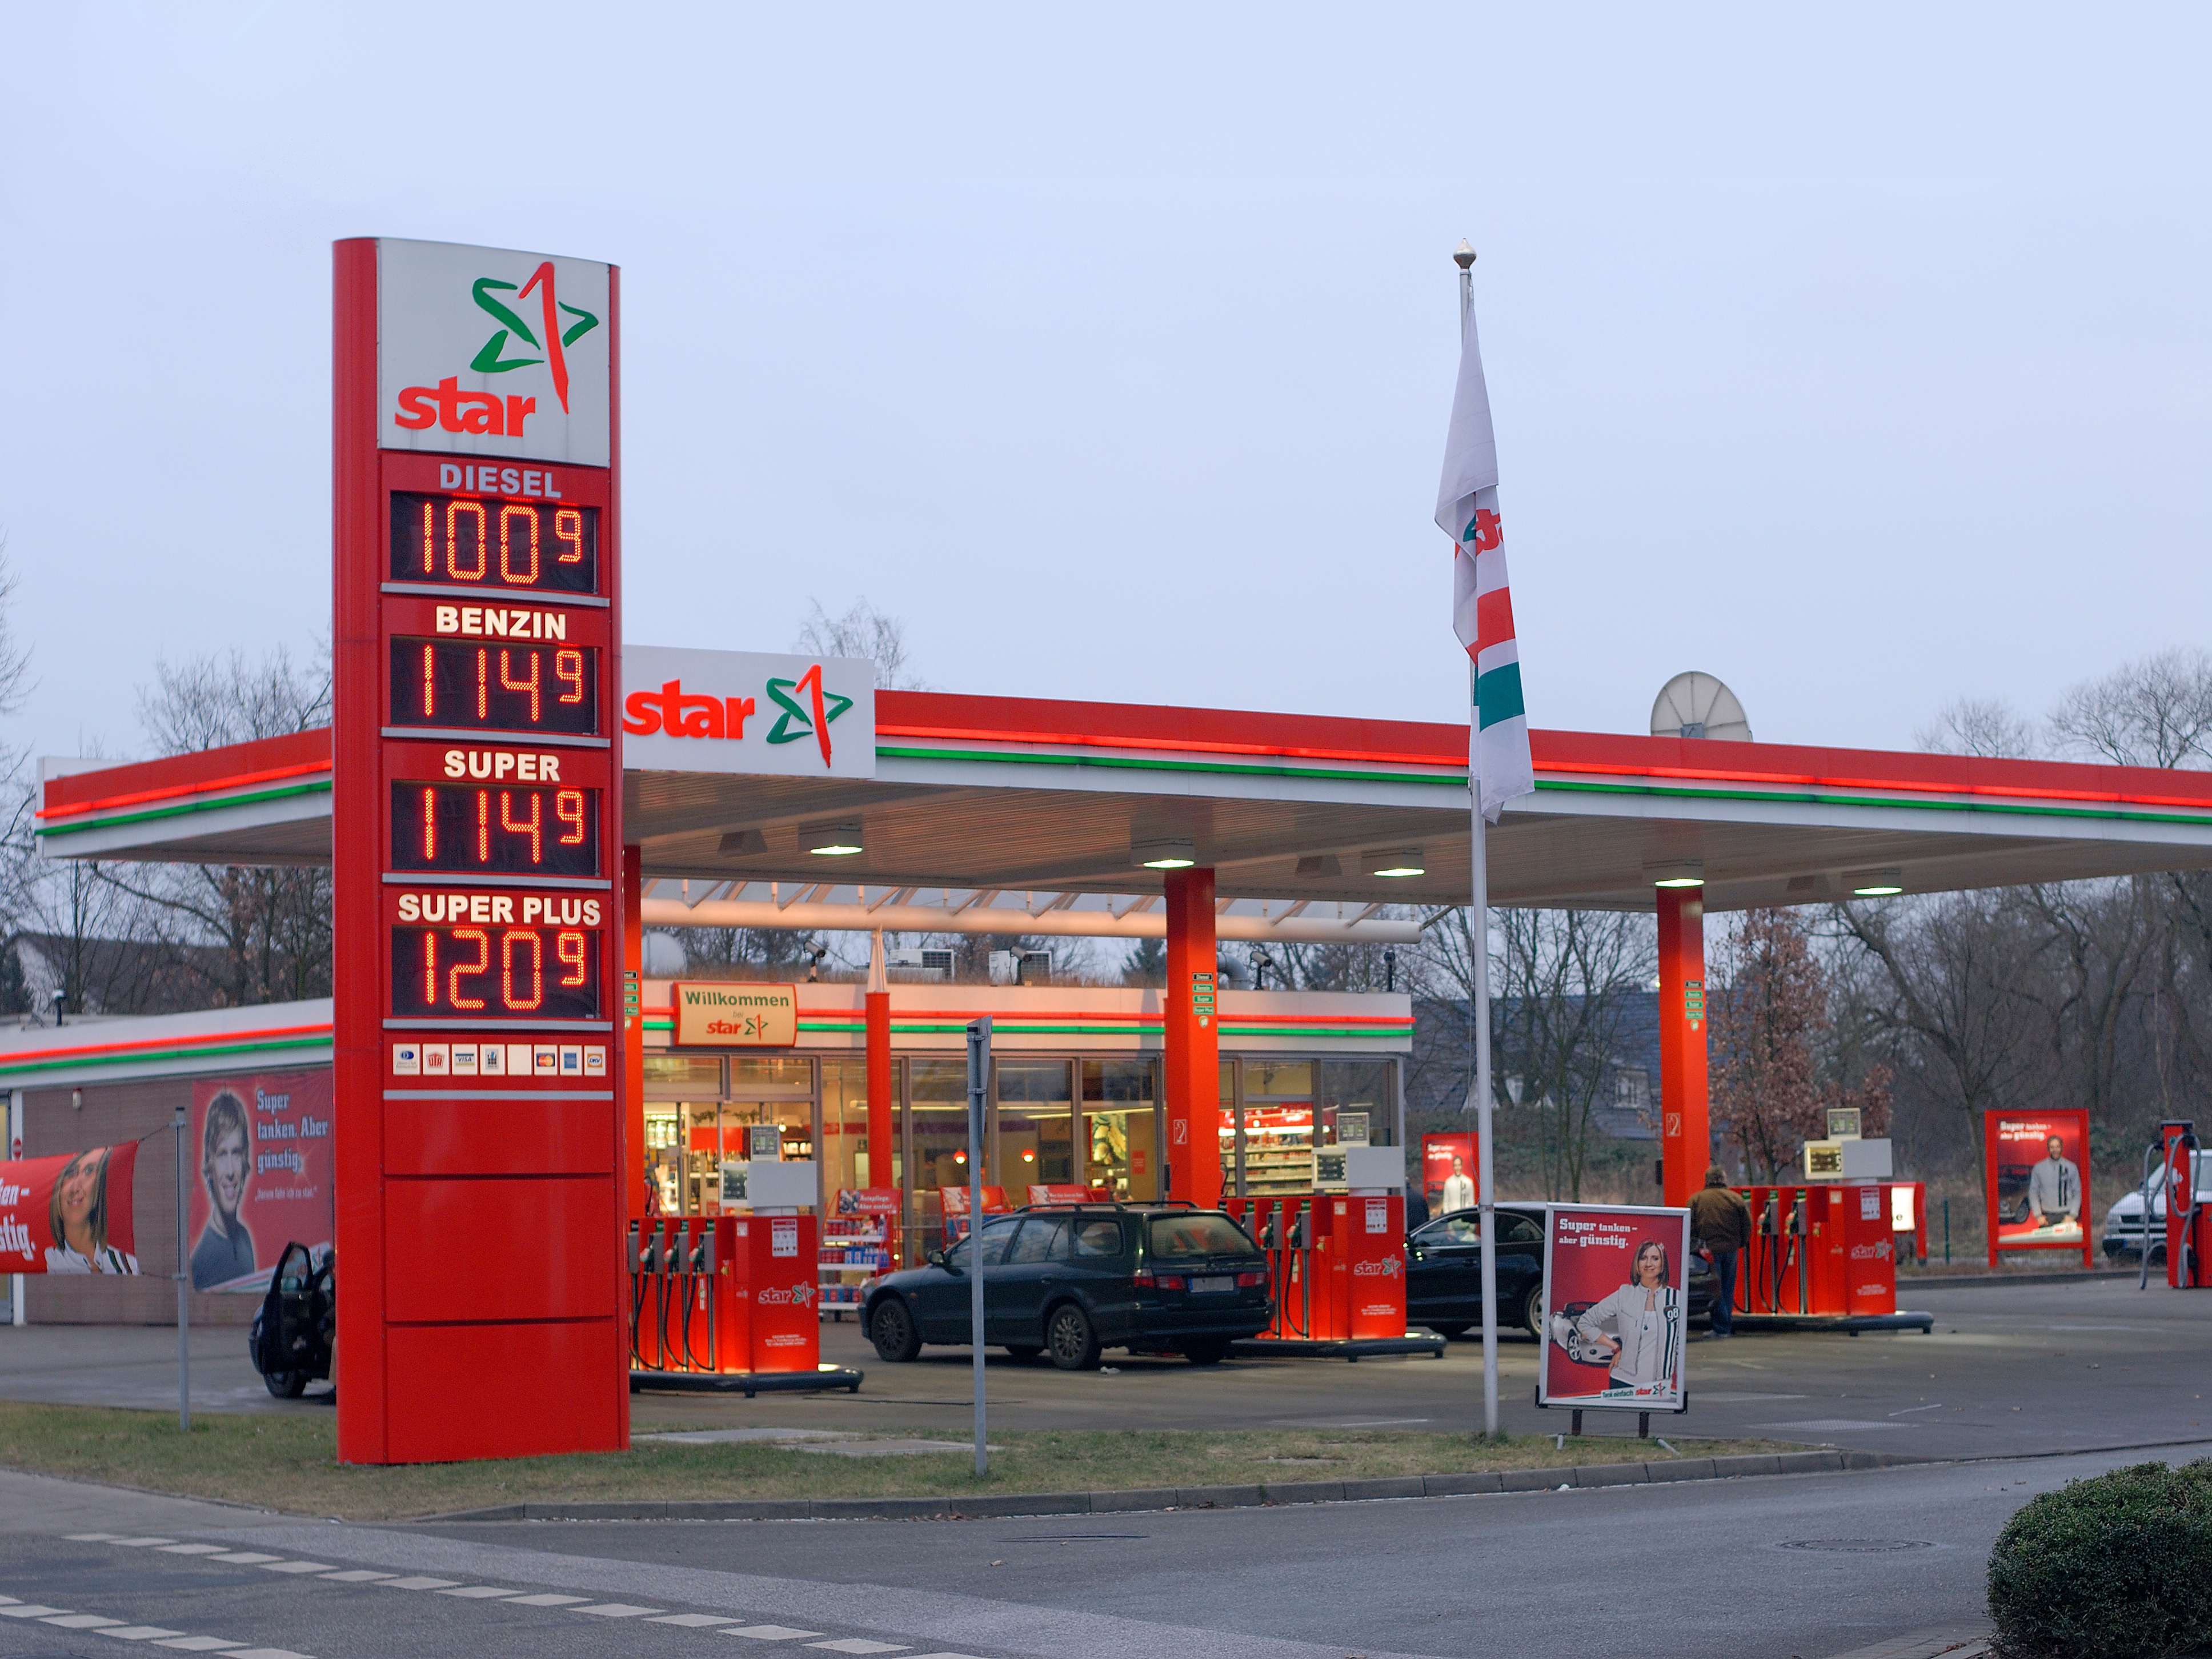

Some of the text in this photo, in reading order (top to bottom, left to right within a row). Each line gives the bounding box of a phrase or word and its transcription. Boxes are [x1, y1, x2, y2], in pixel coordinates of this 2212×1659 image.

[394, 375, 535, 437] star
[439, 463, 562, 498] DIESEL
[436, 606, 566, 640] BENZIN
[623, 679, 755, 739] star
[444, 750, 560, 781] SUPER
[398, 894, 600, 926] SUPER PLUS
[685, 991, 789, 1006] Willkommen
[706, 1019, 741, 1035] star
[257, 1088, 290, 1115] Super
[300, 1115, 328, 1137] Aber
[1559, 1218, 1597, 1233] Super
[1580, 1234, 1629, 1249] günstig.
[1354, 1260, 1382, 1276] star
[758, 1287, 792, 1304] star
[1667, 1308, 1679, 1321] 98
[1635, 1387, 1652, 1396] star
